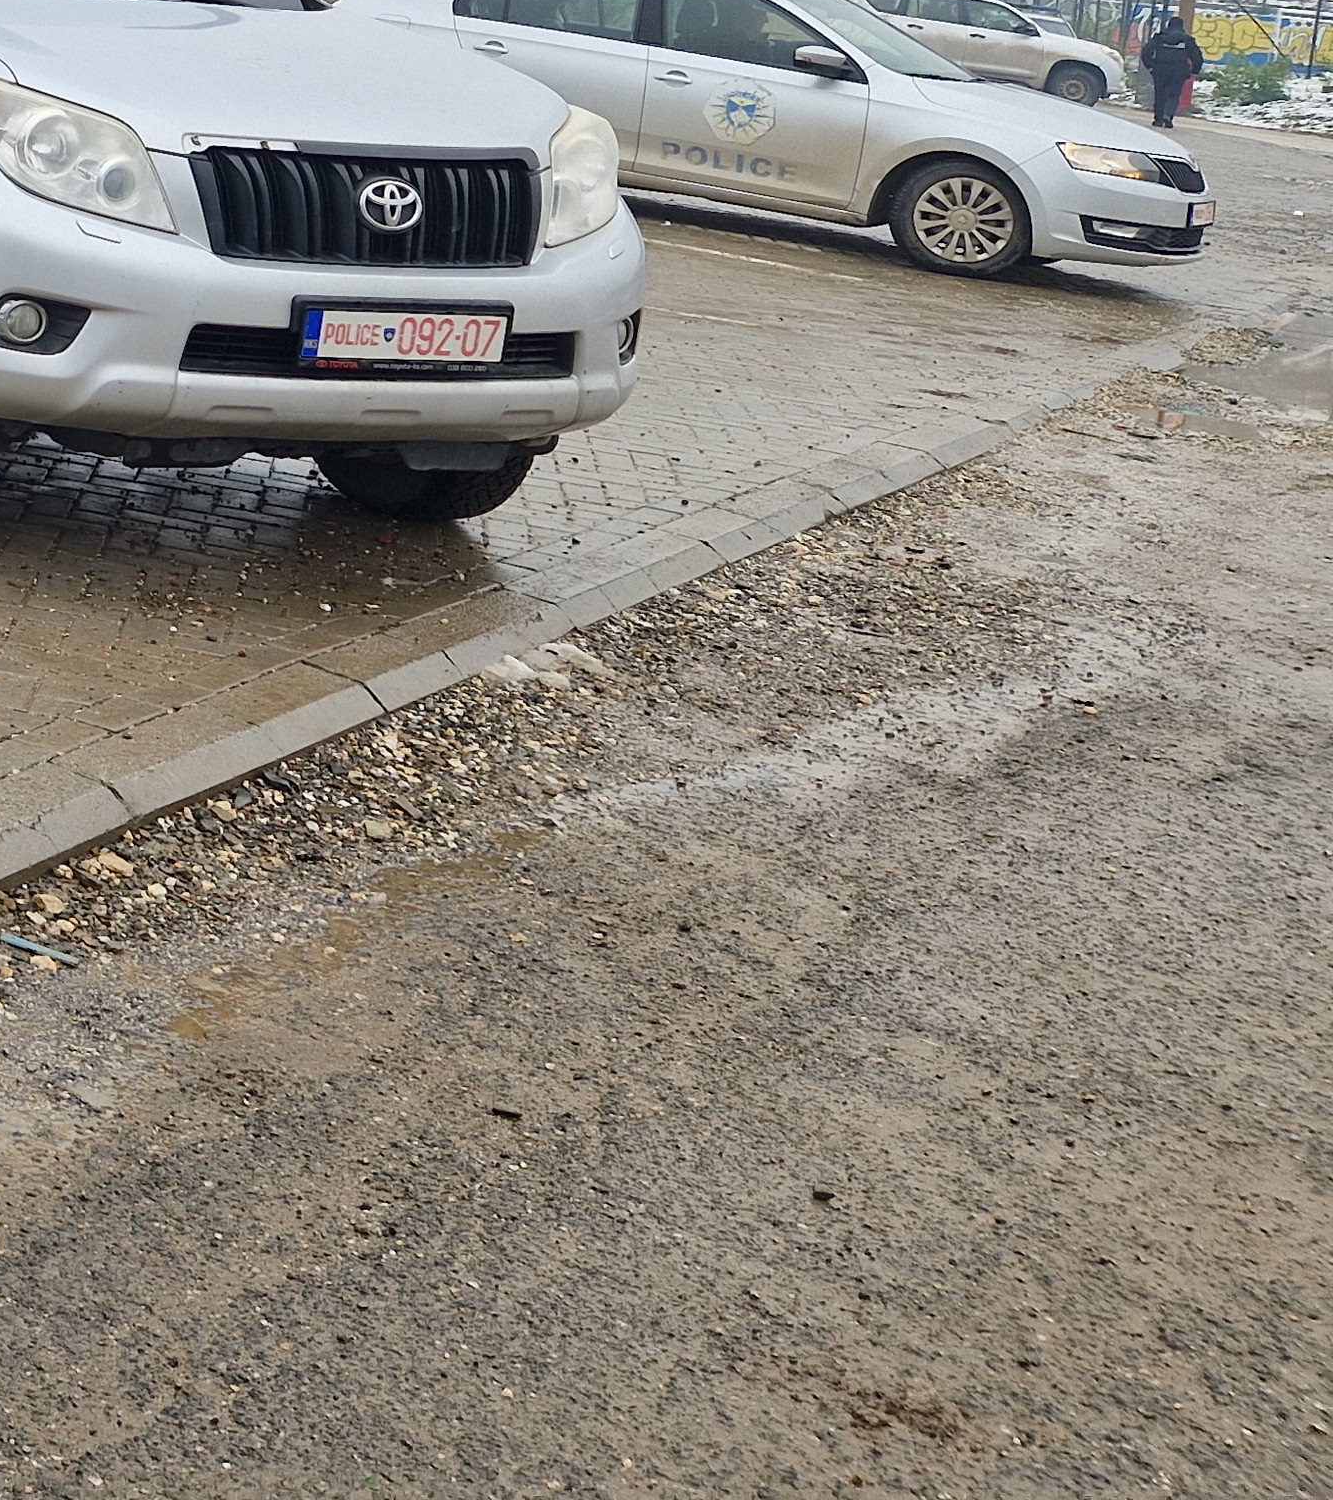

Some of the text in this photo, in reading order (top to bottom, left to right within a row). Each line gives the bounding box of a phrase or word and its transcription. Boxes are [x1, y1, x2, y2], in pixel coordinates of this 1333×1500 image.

[661, 141, 797, 182] POLICE
[323, 317, 501, 357] POLICE 092-07
